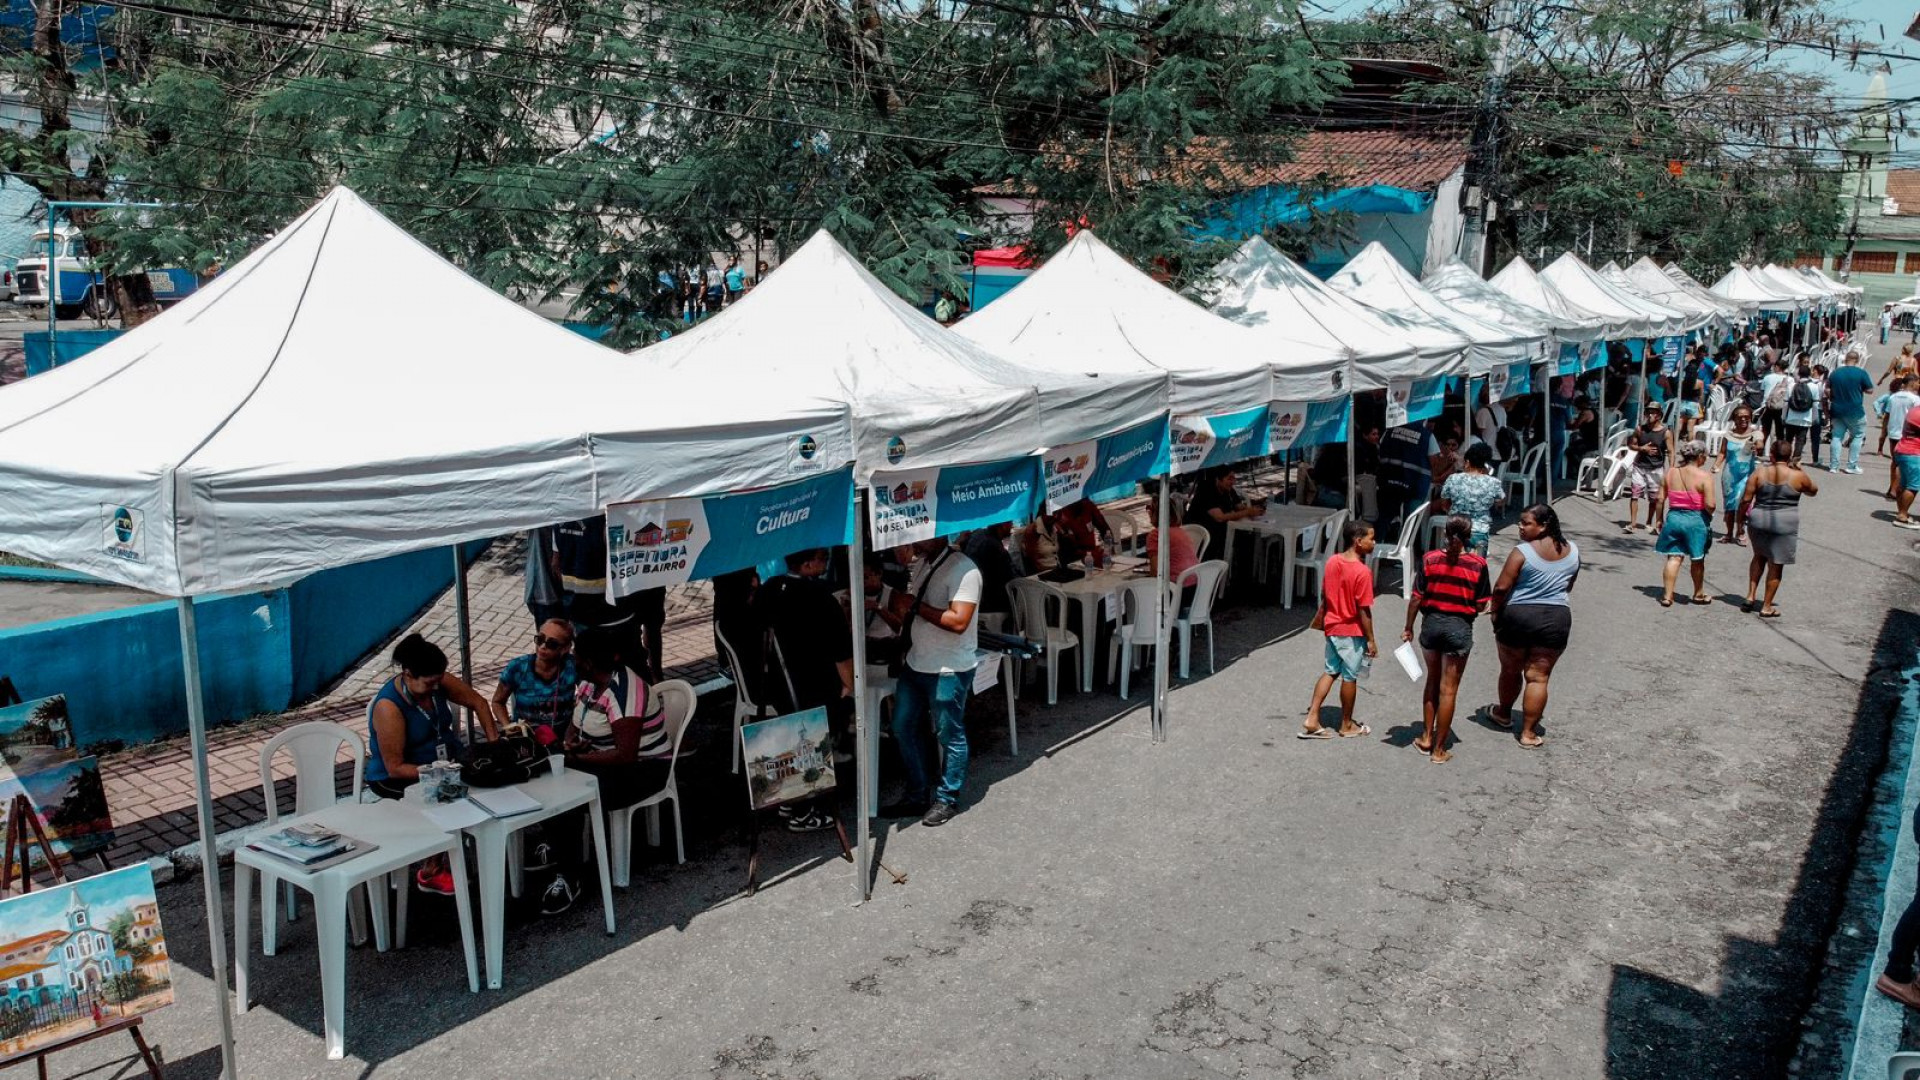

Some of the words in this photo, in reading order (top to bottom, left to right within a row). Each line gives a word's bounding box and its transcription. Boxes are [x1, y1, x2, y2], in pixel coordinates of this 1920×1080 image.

[951, 487, 976, 504] Meio
[978, 480, 1028, 499] Ambiente
[756, 506, 810, 534] Cultura
[876, 524, 889, 534] NO
[890, 521, 904, 532] SEU
[610, 545, 687, 568] REFEITURA
[619, 564, 639, 579] SEU
[642, 559, 686, 574] BAIRRO
